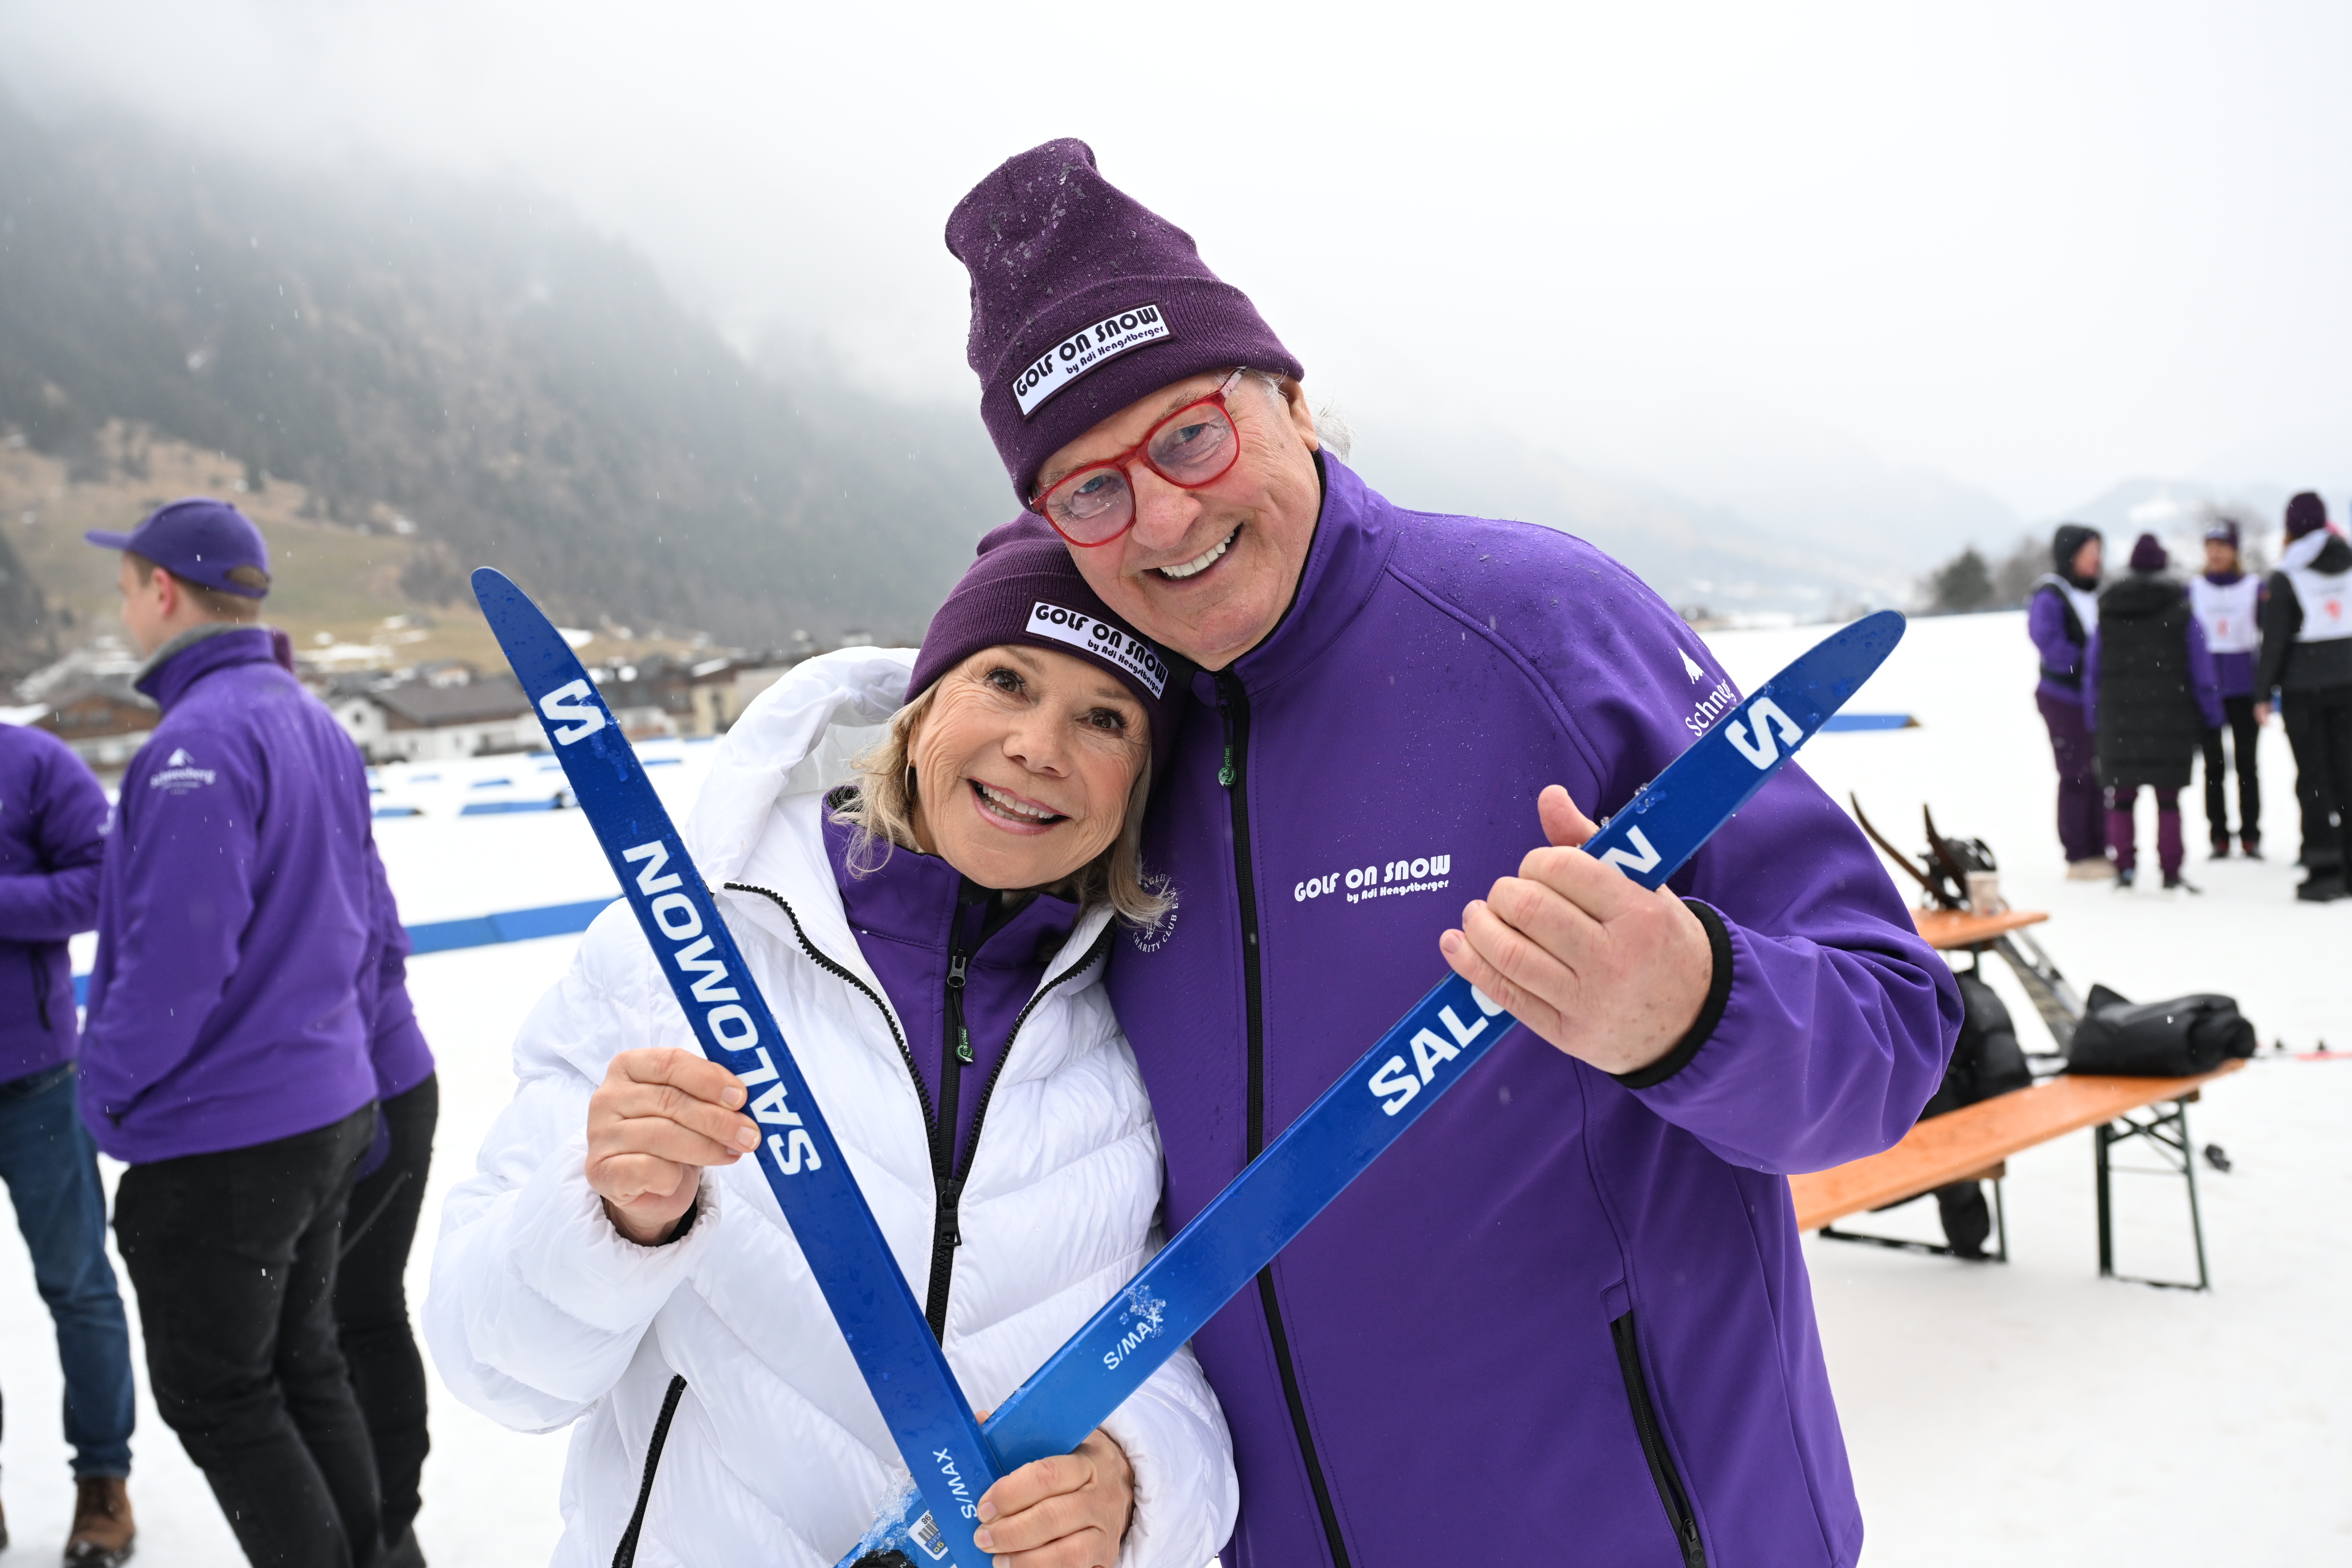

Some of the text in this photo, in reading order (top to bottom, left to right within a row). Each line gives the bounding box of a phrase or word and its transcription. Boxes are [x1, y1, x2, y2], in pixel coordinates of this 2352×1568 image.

[1016, 307, 1159, 397] GOLF ON SNOW
[1066, 325, 1164, 374] by Adi Hengstberger
[1035, 605, 1167, 684] GOLF ON SNOW
[1087, 639, 1161, 695] by Adi Hengstberger
[1144, 873, 1166, 888] AGLES
[1294, 854, 1451, 902] GOLF ON SNOW
[1346, 880, 1449, 904] by Adi Hengstberger
[1133, 932, 1161, 953] CHARITY
[1162, 914, 1178, 942] CLUB
[1368, 824, 1662, 1116] SALN
[622, 839, 823, 1176] SALOMON
[1103, 1310, 1164, 1370] S/MAX
[932, 1447, 978, 1519] S/MAX
